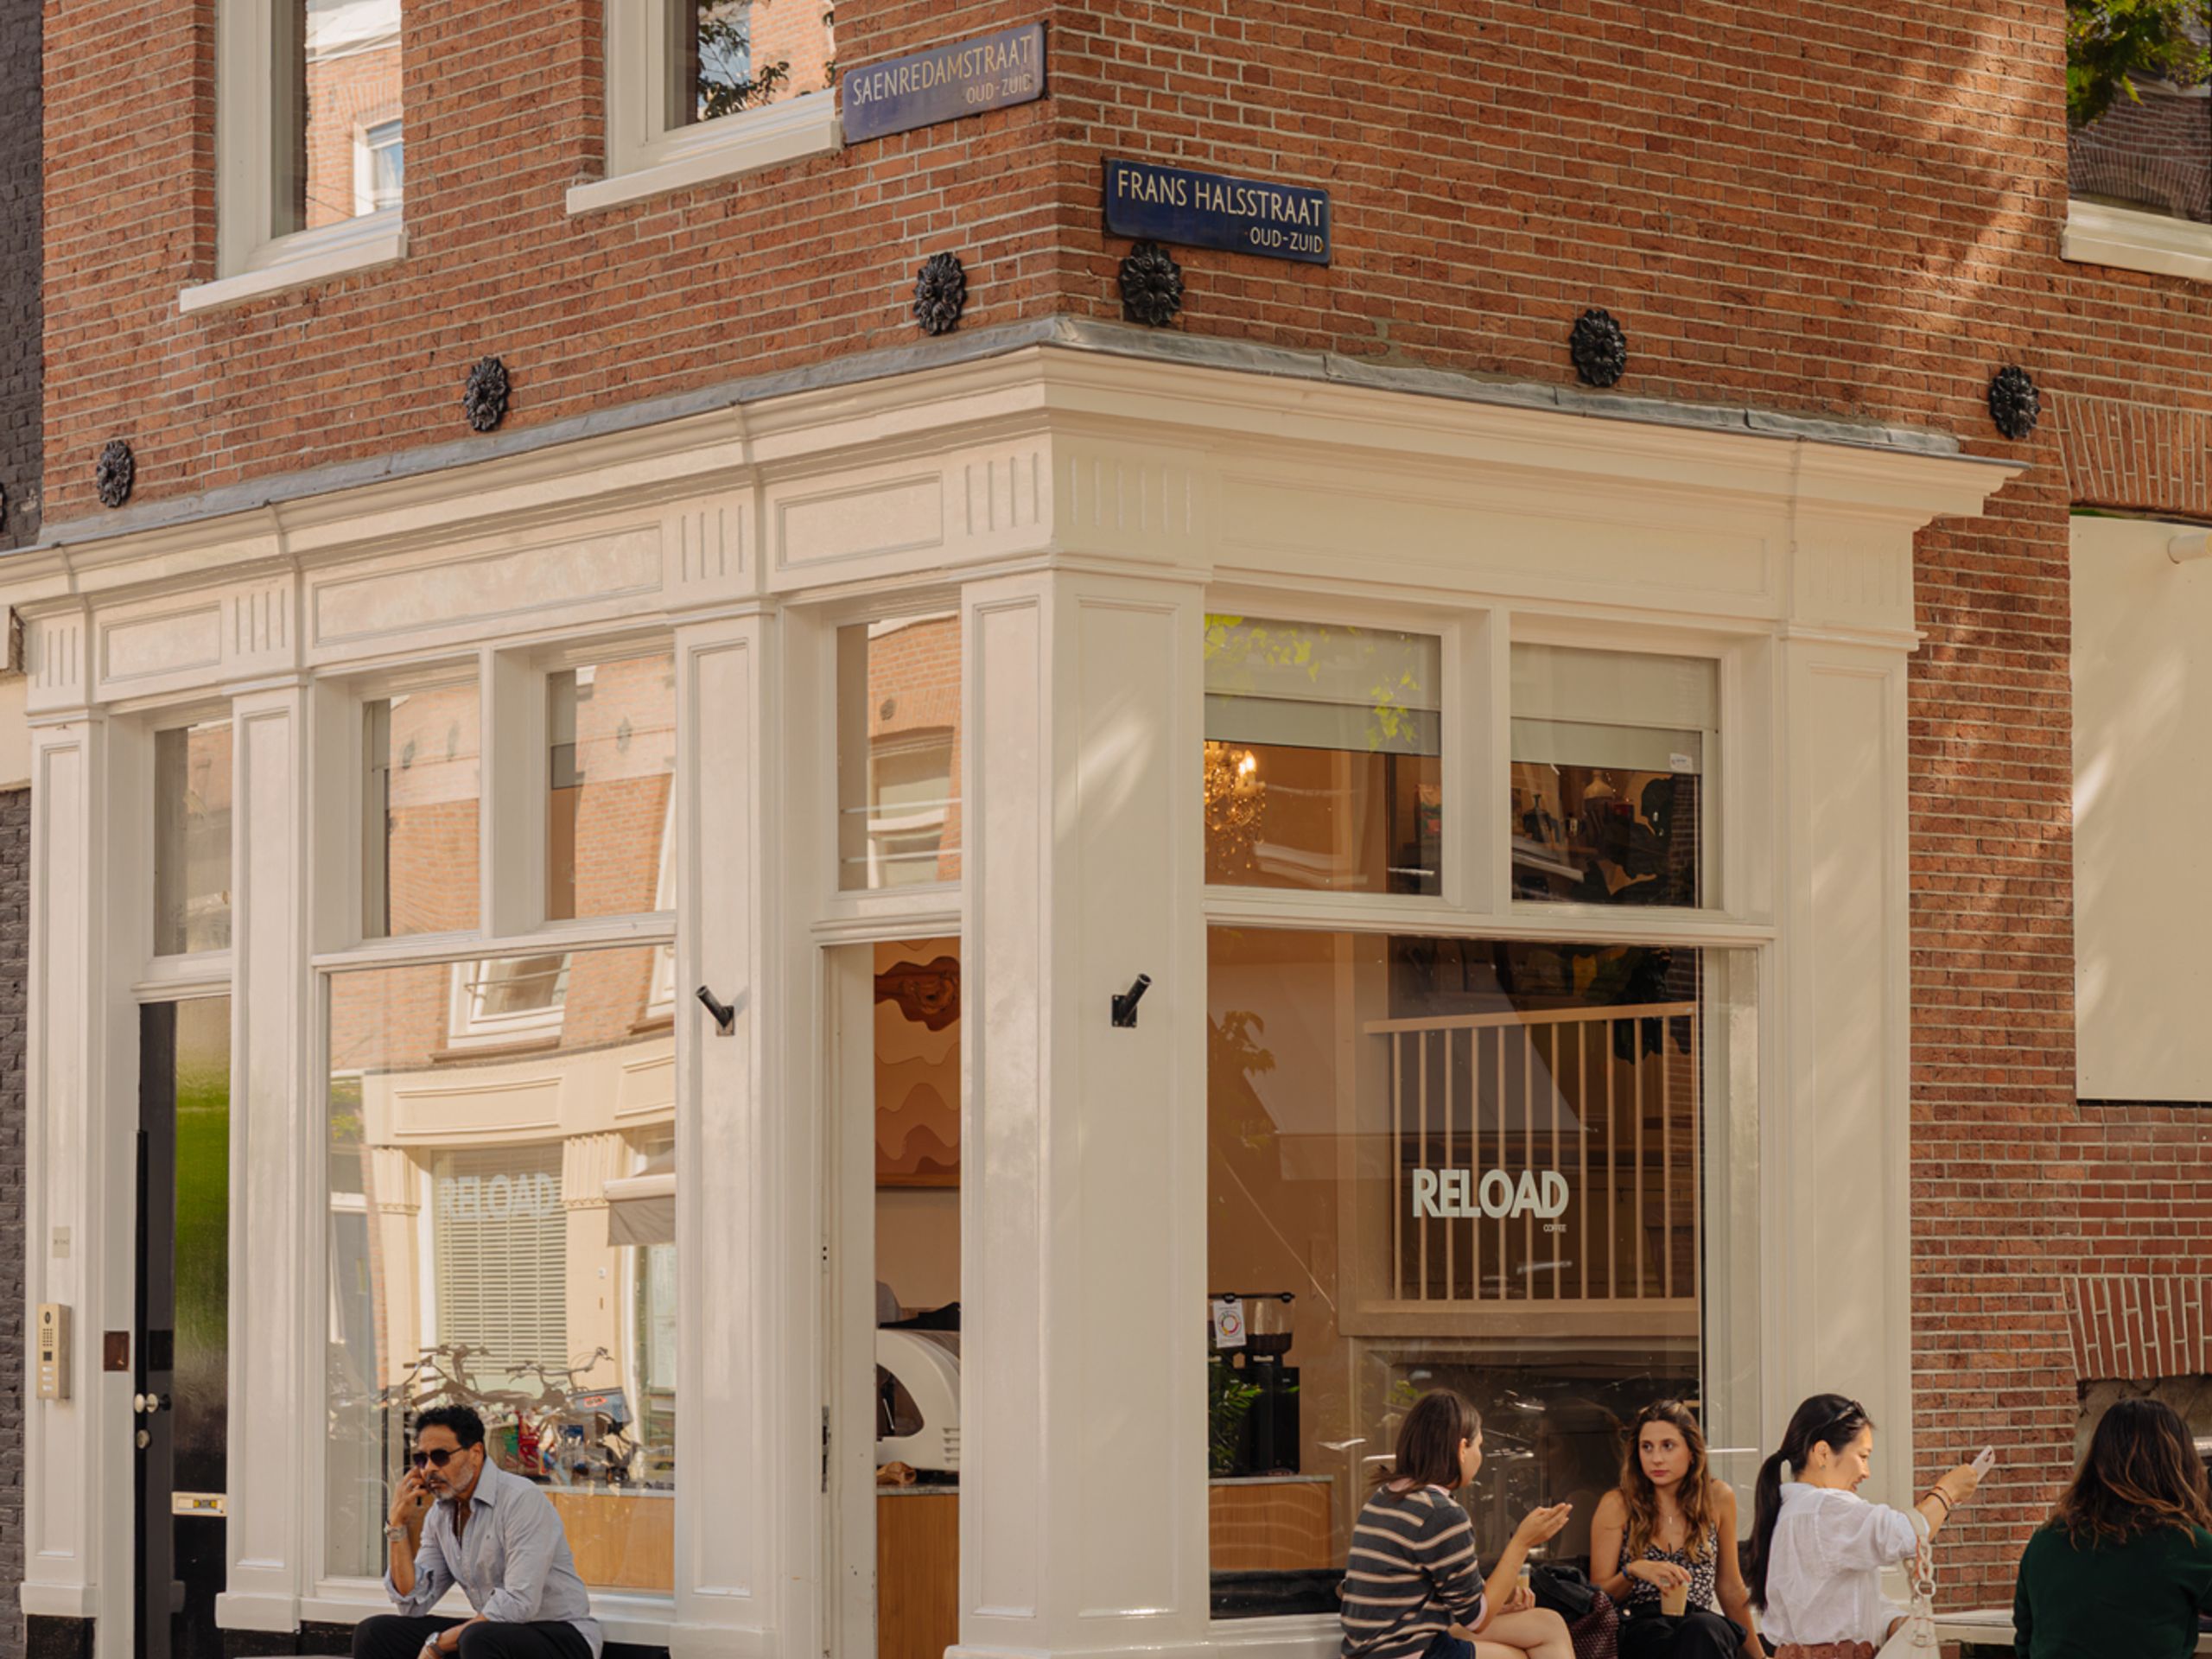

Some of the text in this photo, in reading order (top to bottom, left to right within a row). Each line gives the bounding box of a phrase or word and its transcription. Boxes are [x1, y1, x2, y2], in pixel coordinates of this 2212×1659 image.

[853, 35, 1032, 105] SAENREDAMSTRAAT
[966, 73, 1032, 104] OUD-ZUID
[1118, 169, 1323, 226] FRANS HALSSTRAAT
[1249, 226, 1324, 253] OUD-ZUID
[439, 1173, 556, 1219] RELOAD
[1413, 1168, 1569, 1218] RELOAD
